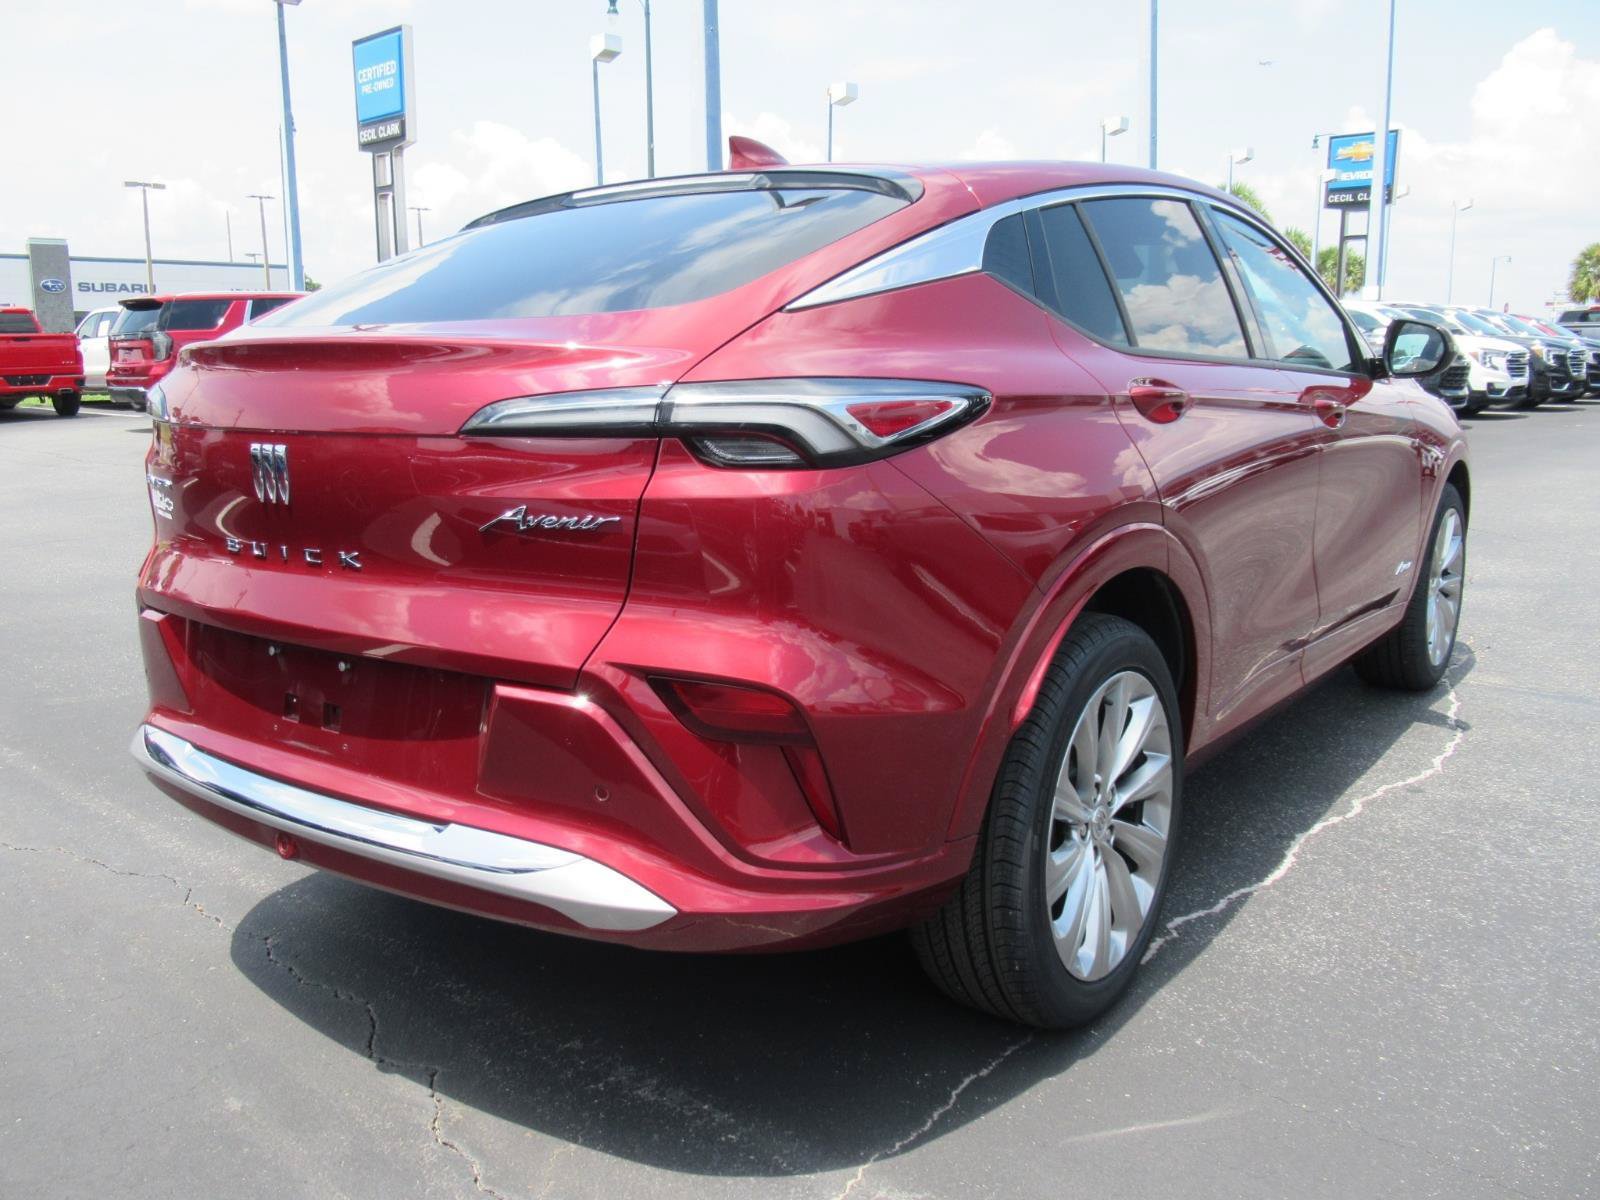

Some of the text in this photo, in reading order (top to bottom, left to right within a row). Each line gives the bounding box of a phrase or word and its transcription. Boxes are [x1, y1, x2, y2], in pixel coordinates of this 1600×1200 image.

[358, 60, 396, 83] CERTIFIED
[361, 78, 393, 94] PRE-OWNED
[360, 122, 400, 143] CECIL CLARK
[1328, 193, 1354, 203] CECIL
[77, 281, 157, 294] SUBARU
[478, 504, 622, 532] Avenir
[226, 536, 364, 569] BUICK
